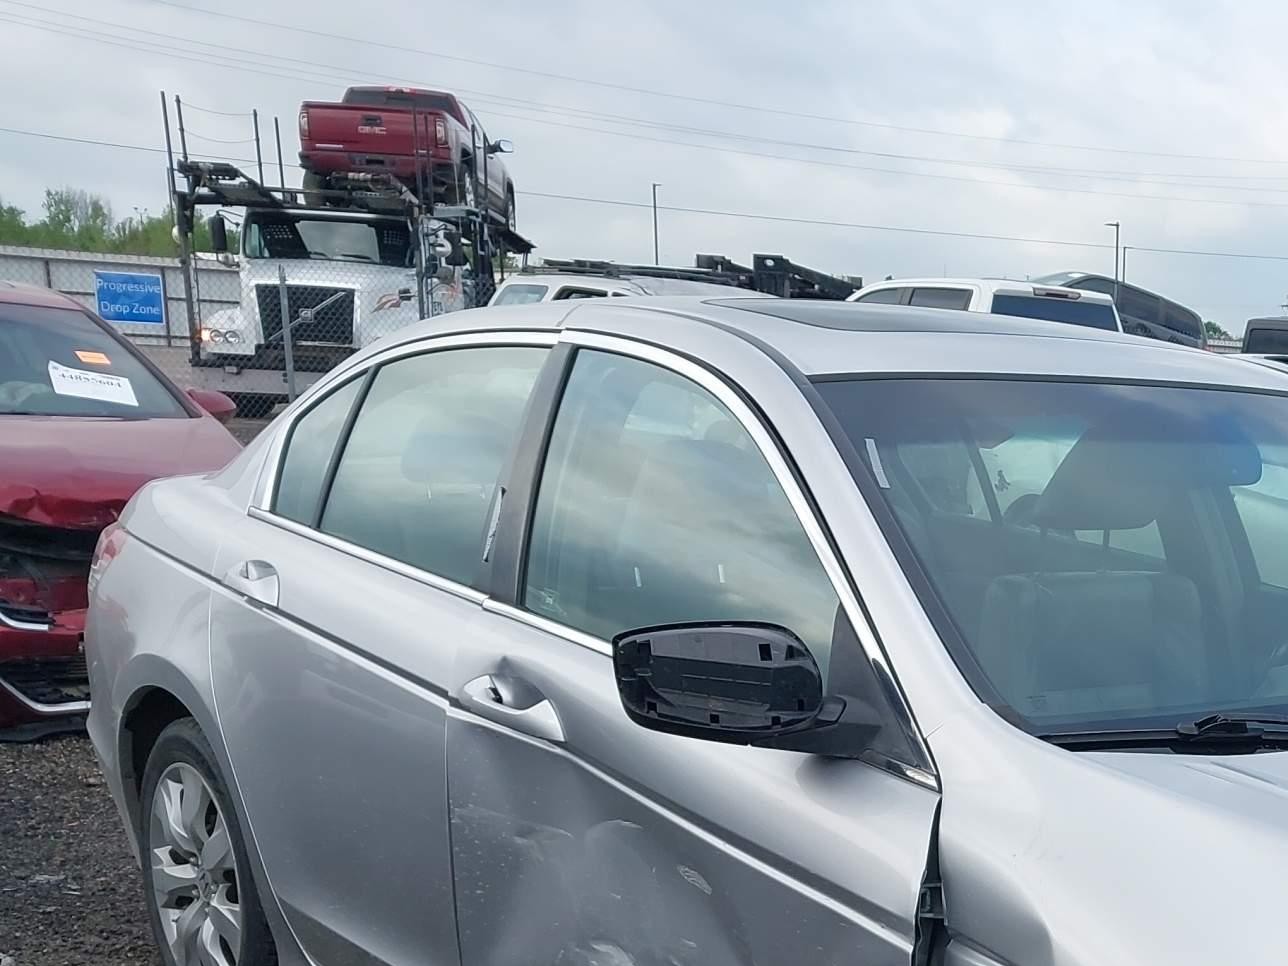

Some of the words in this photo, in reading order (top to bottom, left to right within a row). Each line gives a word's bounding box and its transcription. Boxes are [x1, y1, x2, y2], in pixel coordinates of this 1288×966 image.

[358, 126, 387, 135] GMC
[97, 279, 161, 294] Progressive
[101, 301, 130, 315] Drop
[132, 302, 161, 315] Zone
